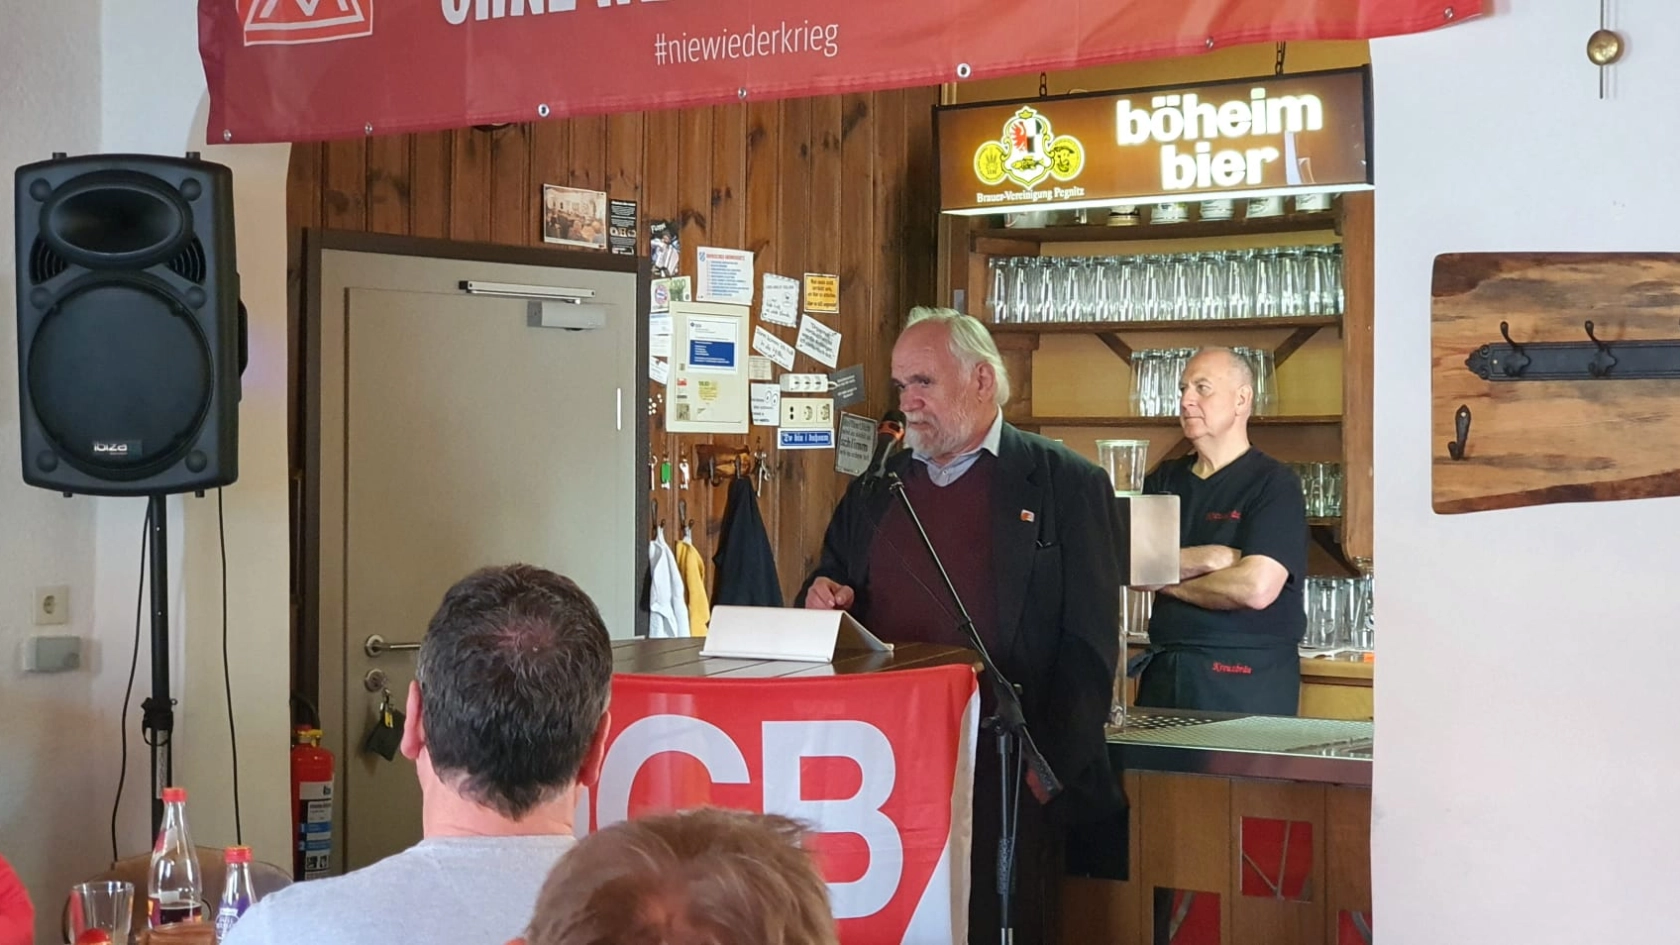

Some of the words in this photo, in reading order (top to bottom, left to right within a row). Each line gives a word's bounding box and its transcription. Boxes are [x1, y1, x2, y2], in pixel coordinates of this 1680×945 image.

[654, 19, 839, 66] #niewiederkrieg
[1116, 87, 1323, 146] böheim
[1160, 142, 1280, 191] bier
[976, 189, 1053, 203] Brauer-Vereinigung
[1053, 186, 1085, 200] Pegnitz
